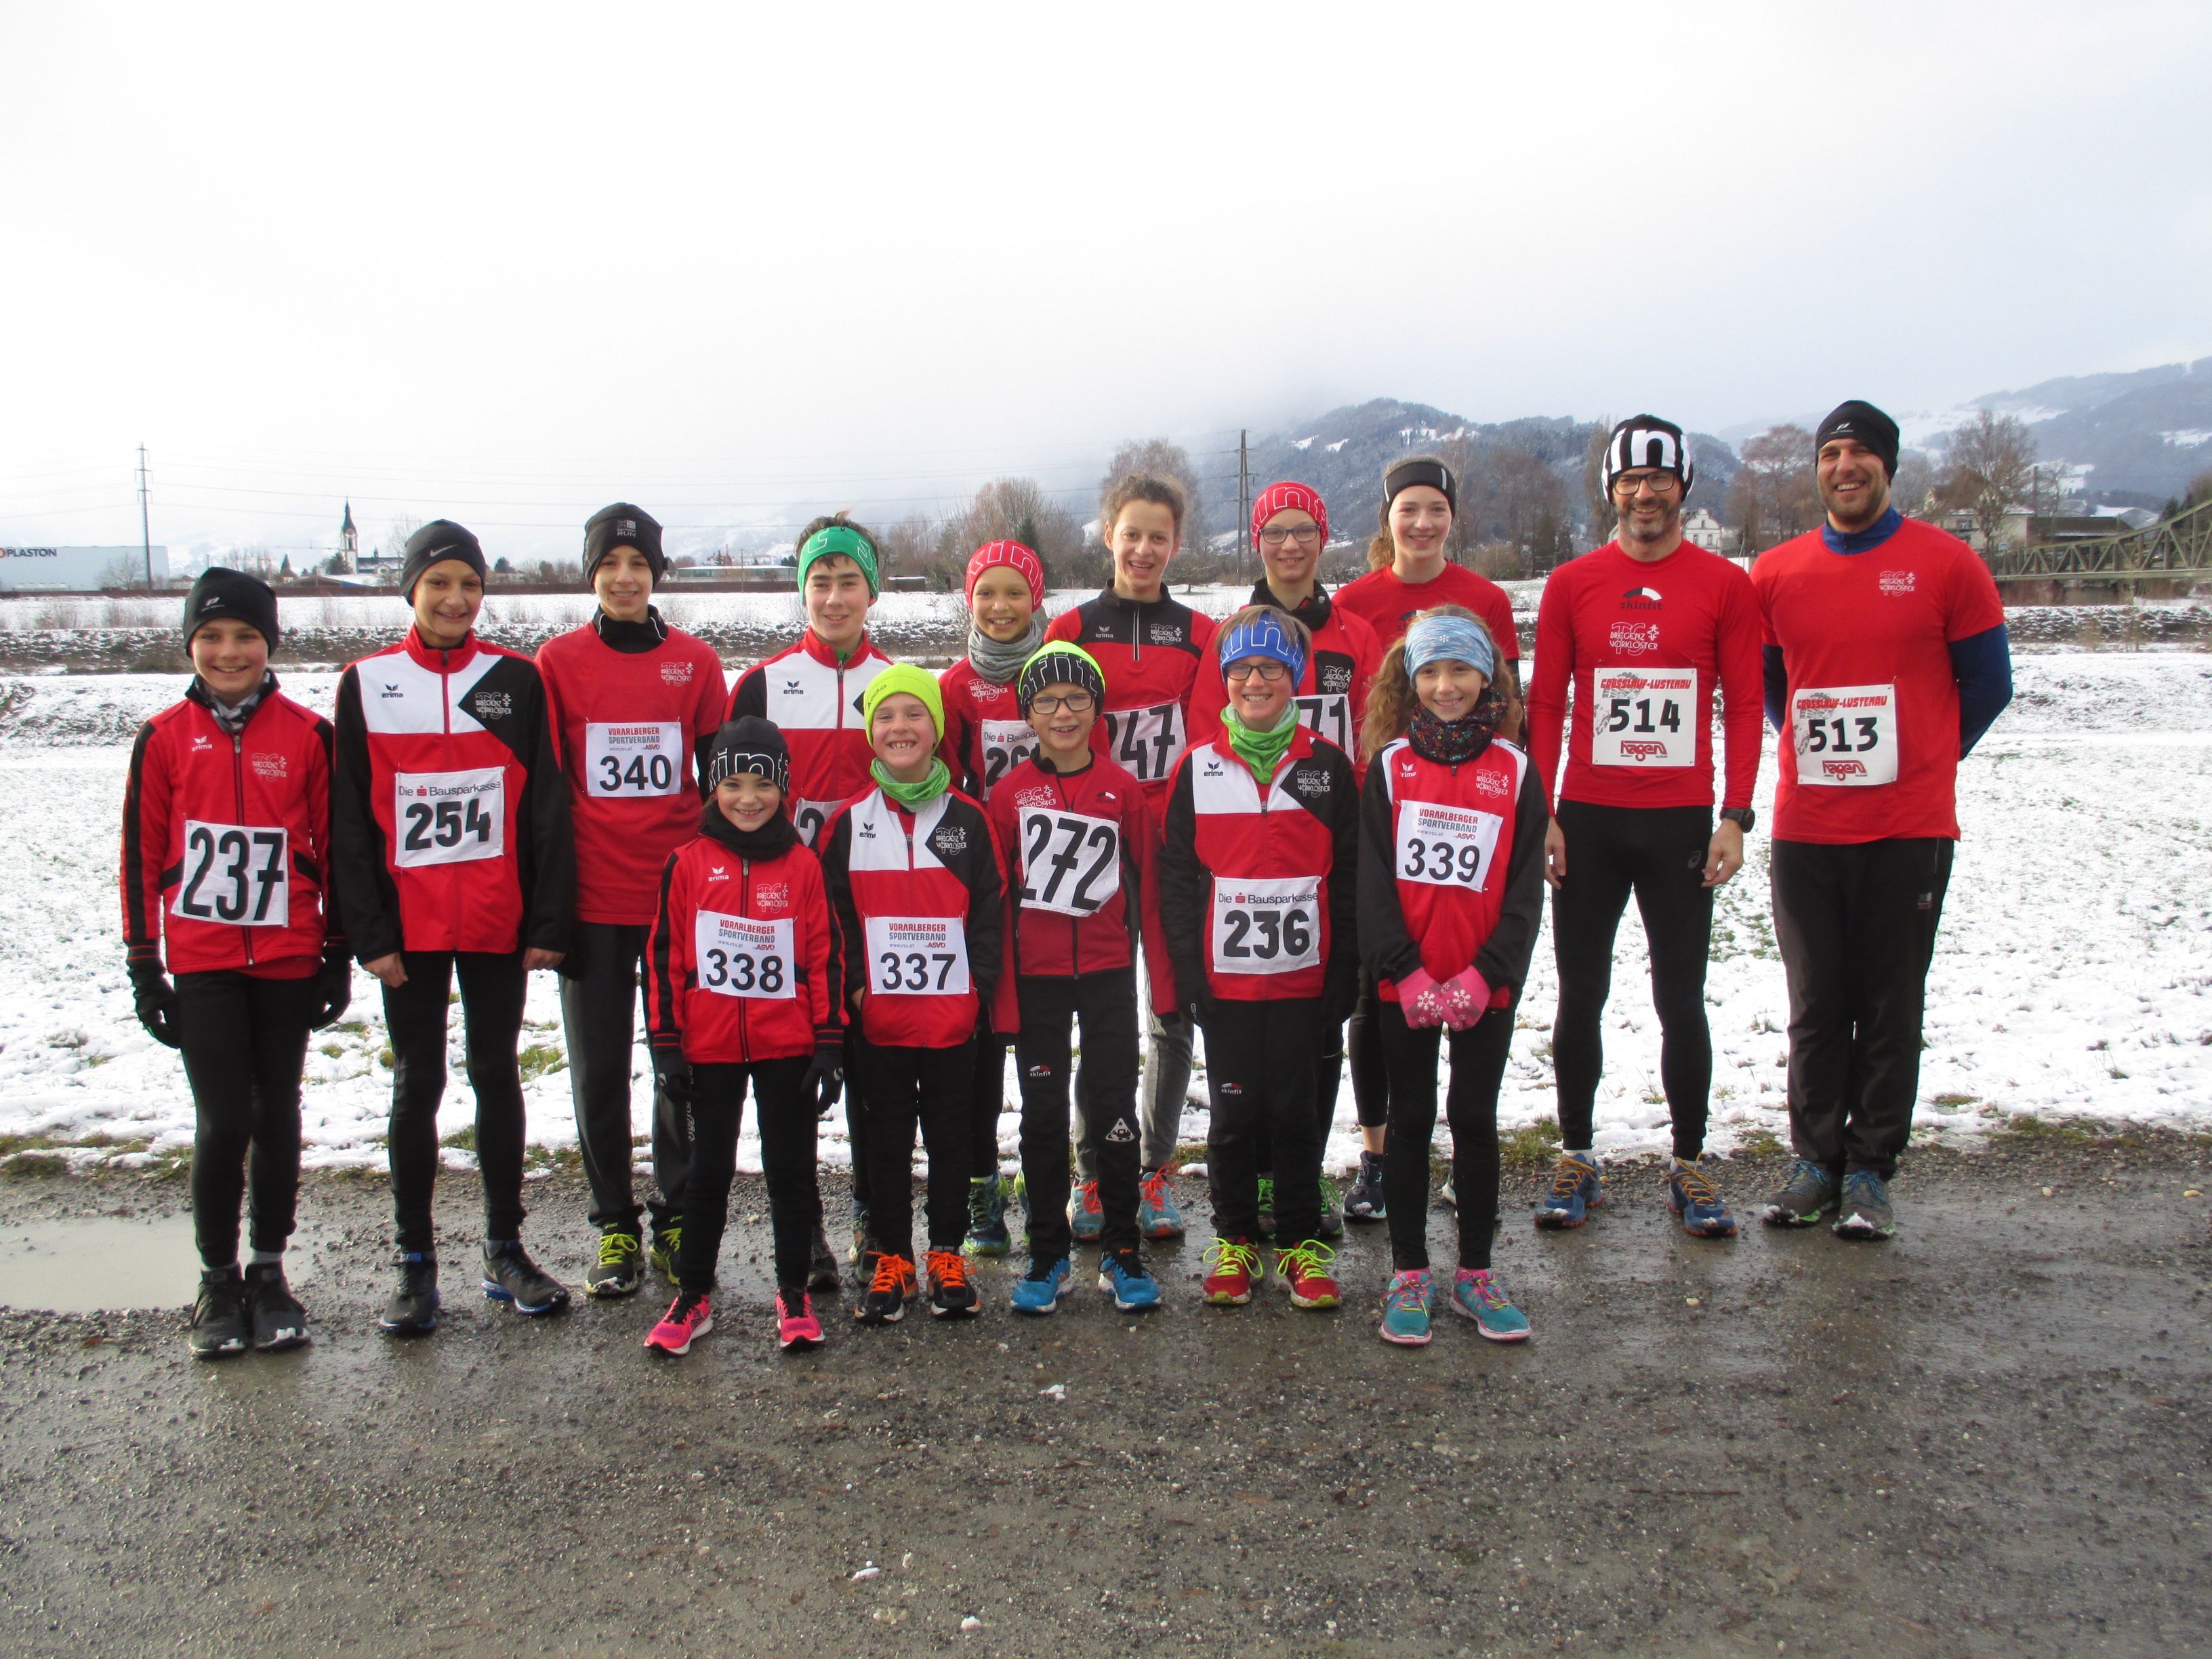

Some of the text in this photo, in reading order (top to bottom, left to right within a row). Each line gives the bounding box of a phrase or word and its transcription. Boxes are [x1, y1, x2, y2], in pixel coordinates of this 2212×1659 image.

[7, 548, 58, 557] PLASTON
[1610, 632, 1646, 641] BREGENZ
[1609, 640, 1659, 651] VORKLOSTER
[1296, 697, 1345, 751] 71
[1609, 698, 1681, 733] 514
[608, 727, 660, 736] VORARLBERGER
[609, 735, 660, 744] SPORTVERBAND
[984, 731, 997, 742] Die
[1808, 716, 1879, 752] 513
[191, 743, 213, 752] erima
[1620, 740, 1668, 762] hagen
[599, 754, 672, 792] 340
[1822, 760, 1868, 781] hagen
[398, 781, 501, 796] Die Bausparkasse
[405, 798, 491, 851] 254
[1419, 808, 1479, 825] VORARLBERGER
[1417, 817, 1477, 834] SPORTVERBAND
[859, 831, 877, 839] erima
[1021, 814, 1117, 911] 272
[1404, 838, 1480, 883] 339
[183, 827, 284, 921] 237
[1218, 892, 1318, 905] Die Bausparkasse
[720, 919, 775, 935] VORARLBERGER
[888, 923, 946, 933] VORARLBERGER
[1223, 909, 1310, 960] 236
[718, 928, 776, 944] SPORTVERBAND
[888, 933, 946, 941] SPORTVERBAND
[705, 948, 784, 993] 338
[880, 951, 956, 991] 337
